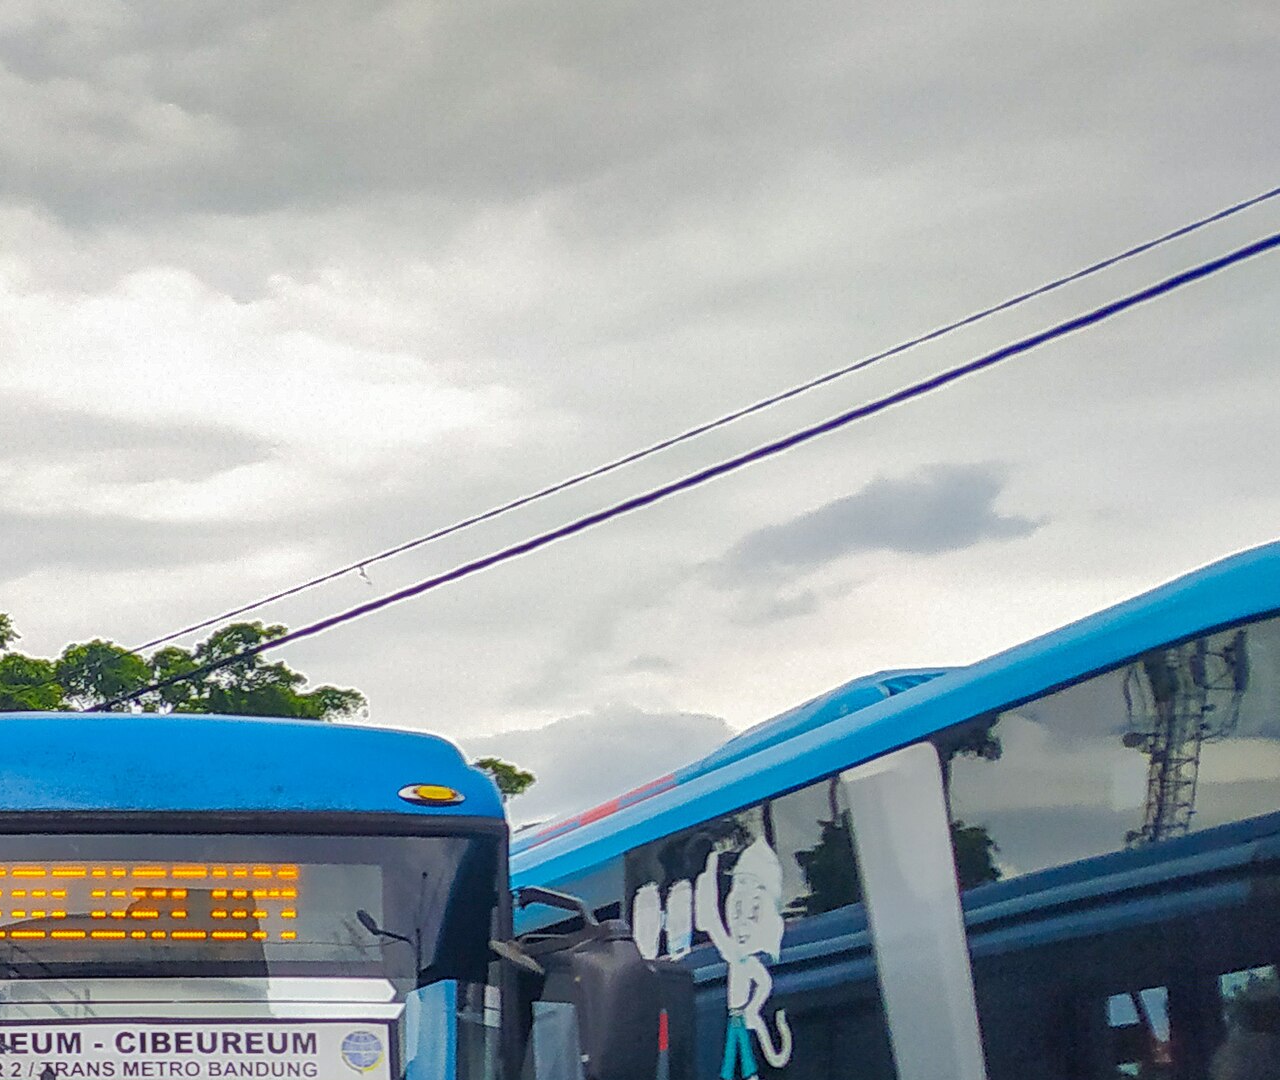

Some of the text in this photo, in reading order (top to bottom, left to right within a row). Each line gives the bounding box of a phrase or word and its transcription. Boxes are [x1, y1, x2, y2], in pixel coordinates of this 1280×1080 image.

[114, 1031, 317, 1055] CIBEUREUM
[10, 1062, 22, 1078] 2
[40, 1061, 116, 1078] TRANS
[123, 1061, 201, 1077] METRO
[208, 1061, 318, 1078] BANDUNG
